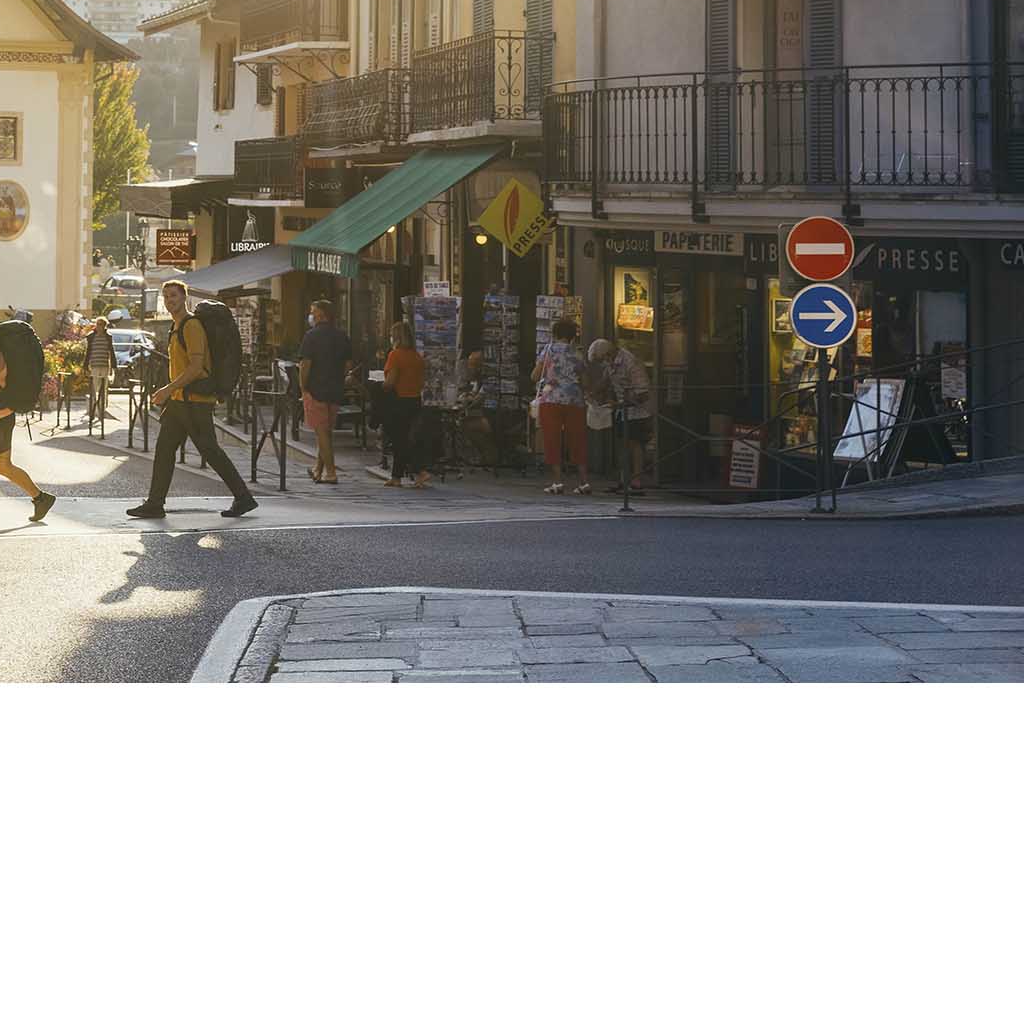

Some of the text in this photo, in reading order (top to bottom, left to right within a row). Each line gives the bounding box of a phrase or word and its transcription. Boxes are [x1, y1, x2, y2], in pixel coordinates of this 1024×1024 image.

[513, 212, 546, 254] PRESS
[231, 242, 270, 252] LIBRAIR
[878, 248, 959, 272] PRESSE
